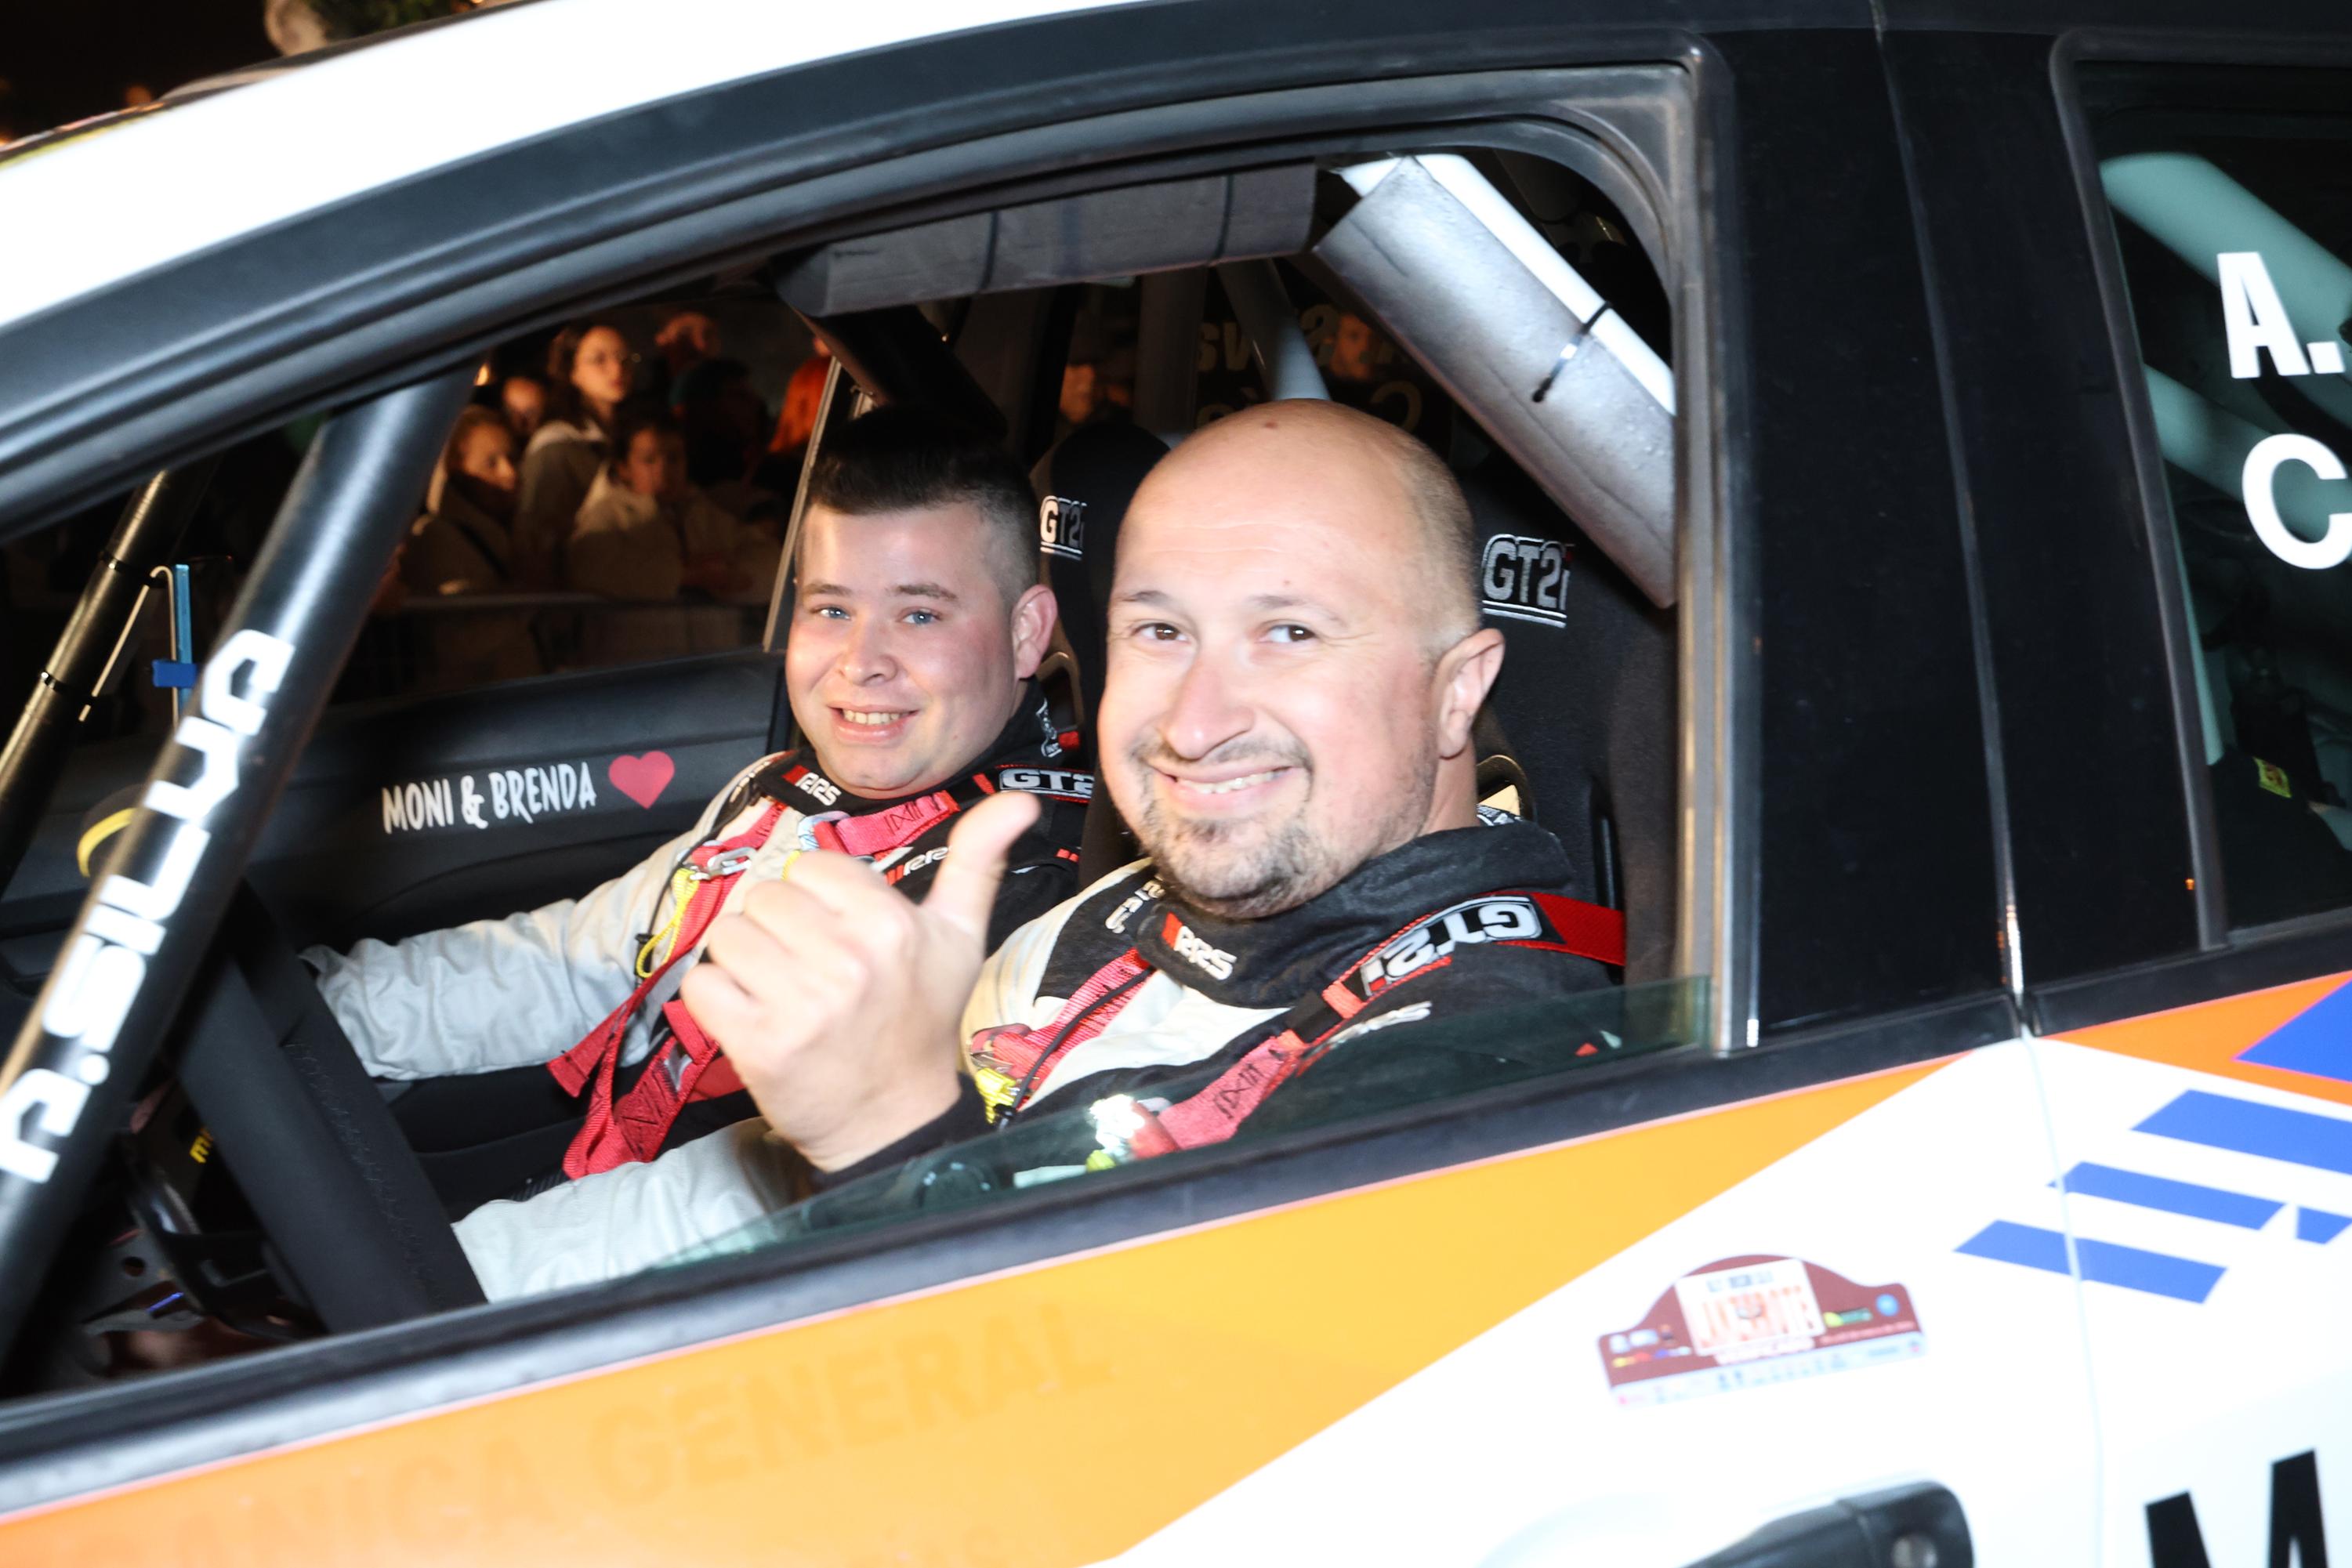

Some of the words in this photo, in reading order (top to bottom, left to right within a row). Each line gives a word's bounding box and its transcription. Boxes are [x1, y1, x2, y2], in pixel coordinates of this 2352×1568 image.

[2217, 252, 2344, 378] A.
[382, 778, 454, 834] MONI
[461, 775, 488, 829] &
[487, 762, 597, 824] BRENDA
